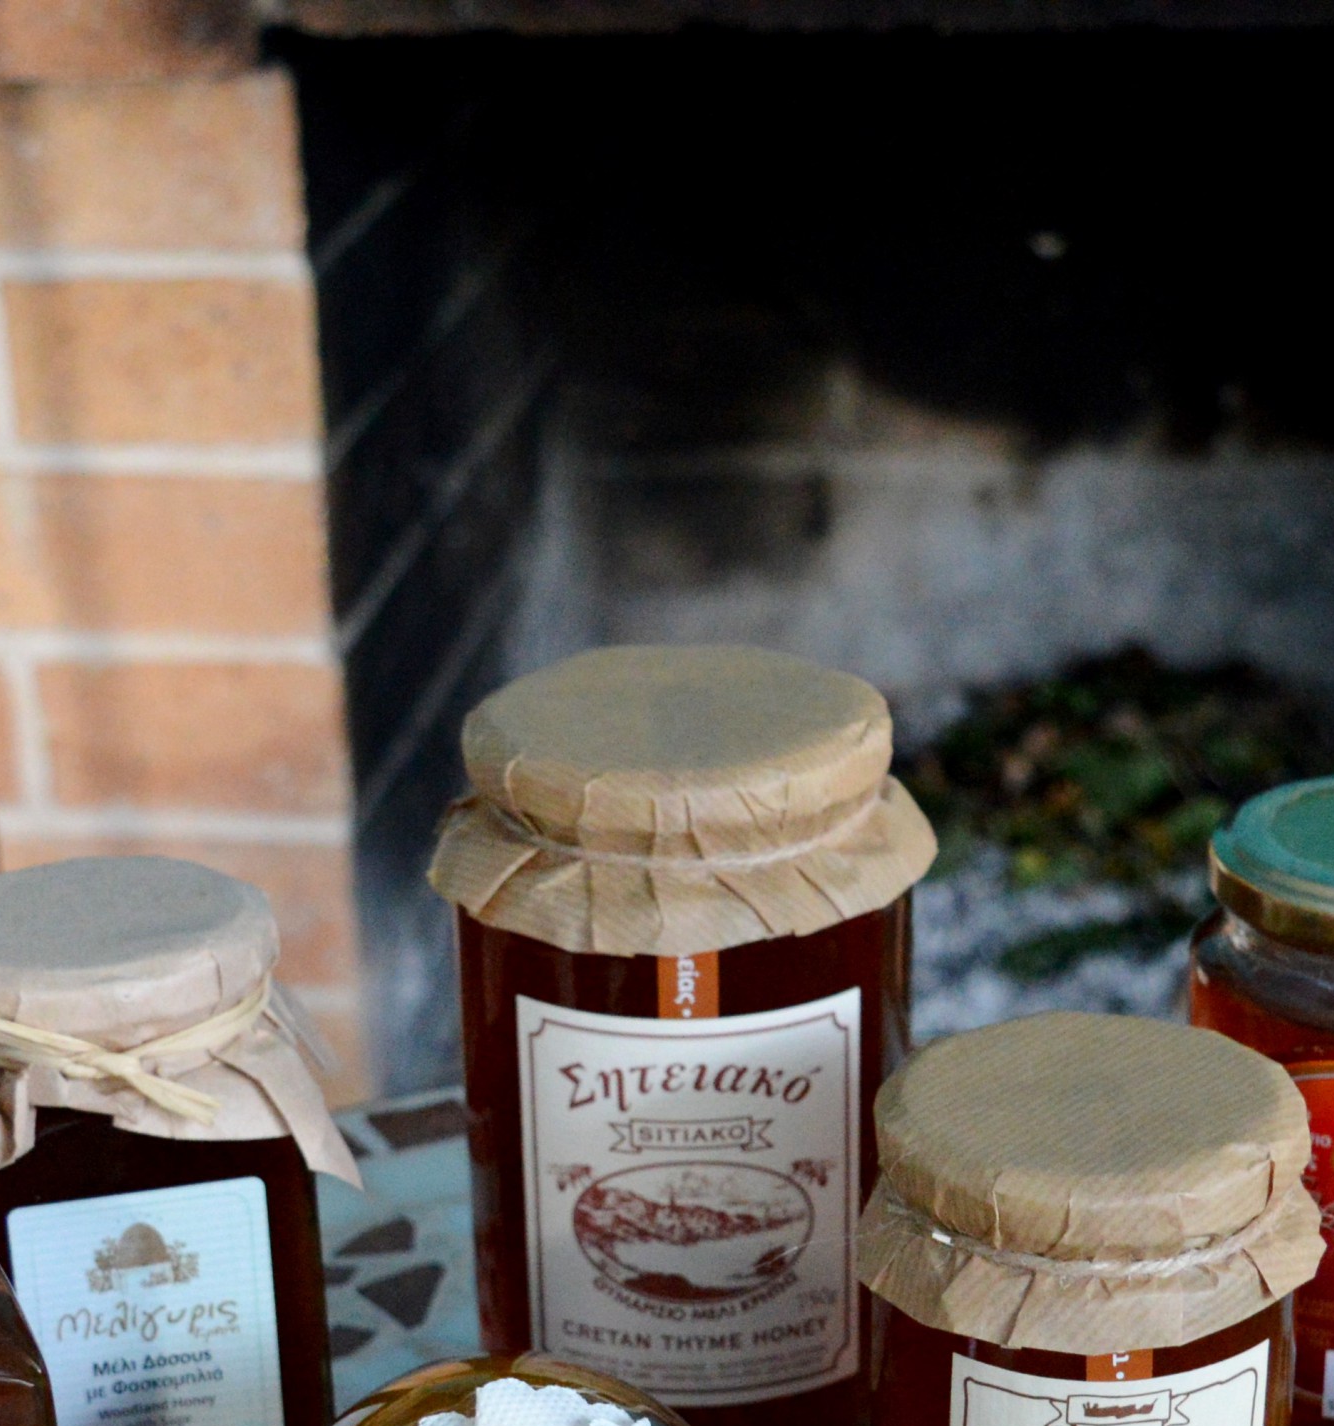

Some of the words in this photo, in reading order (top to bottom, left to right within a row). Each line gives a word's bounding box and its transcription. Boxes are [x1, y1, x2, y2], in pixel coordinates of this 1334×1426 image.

[558, 1061, 821, 1112] Σητειακό
[637, 1125, 748, 1145] SITIAKO
[562, 1319, 652, 1350] CRETAN
[661, 1332, 743, 1351] THYME
[751, 1316, 829, 1346] HONEY
